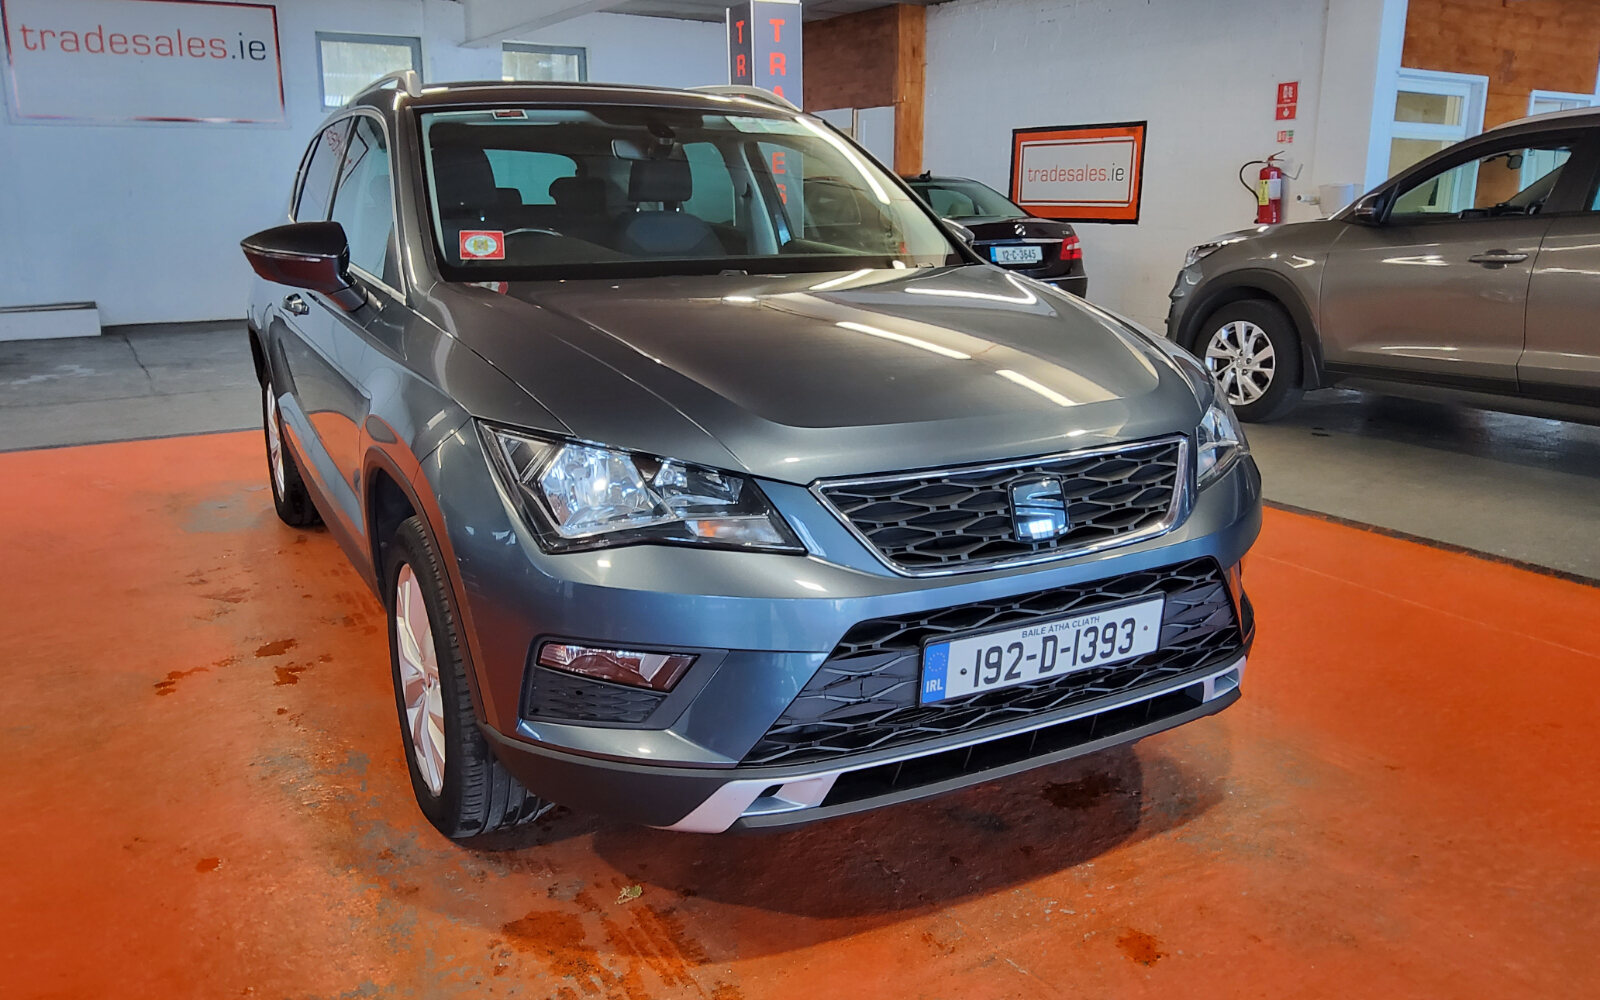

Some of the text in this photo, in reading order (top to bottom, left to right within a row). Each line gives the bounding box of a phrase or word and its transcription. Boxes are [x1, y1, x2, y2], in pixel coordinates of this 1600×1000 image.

[20, 23, 267, 61] tradesales.ie
[1027, 162, 1125, 182] tradesales.ie
[1022, 626, 1047, 638] BAILE
[1071, 616, 1100, 628] CLIATH
[973, 617, 1136, 688] 192-D-1393
[926, 679, 943, 693] IRL
